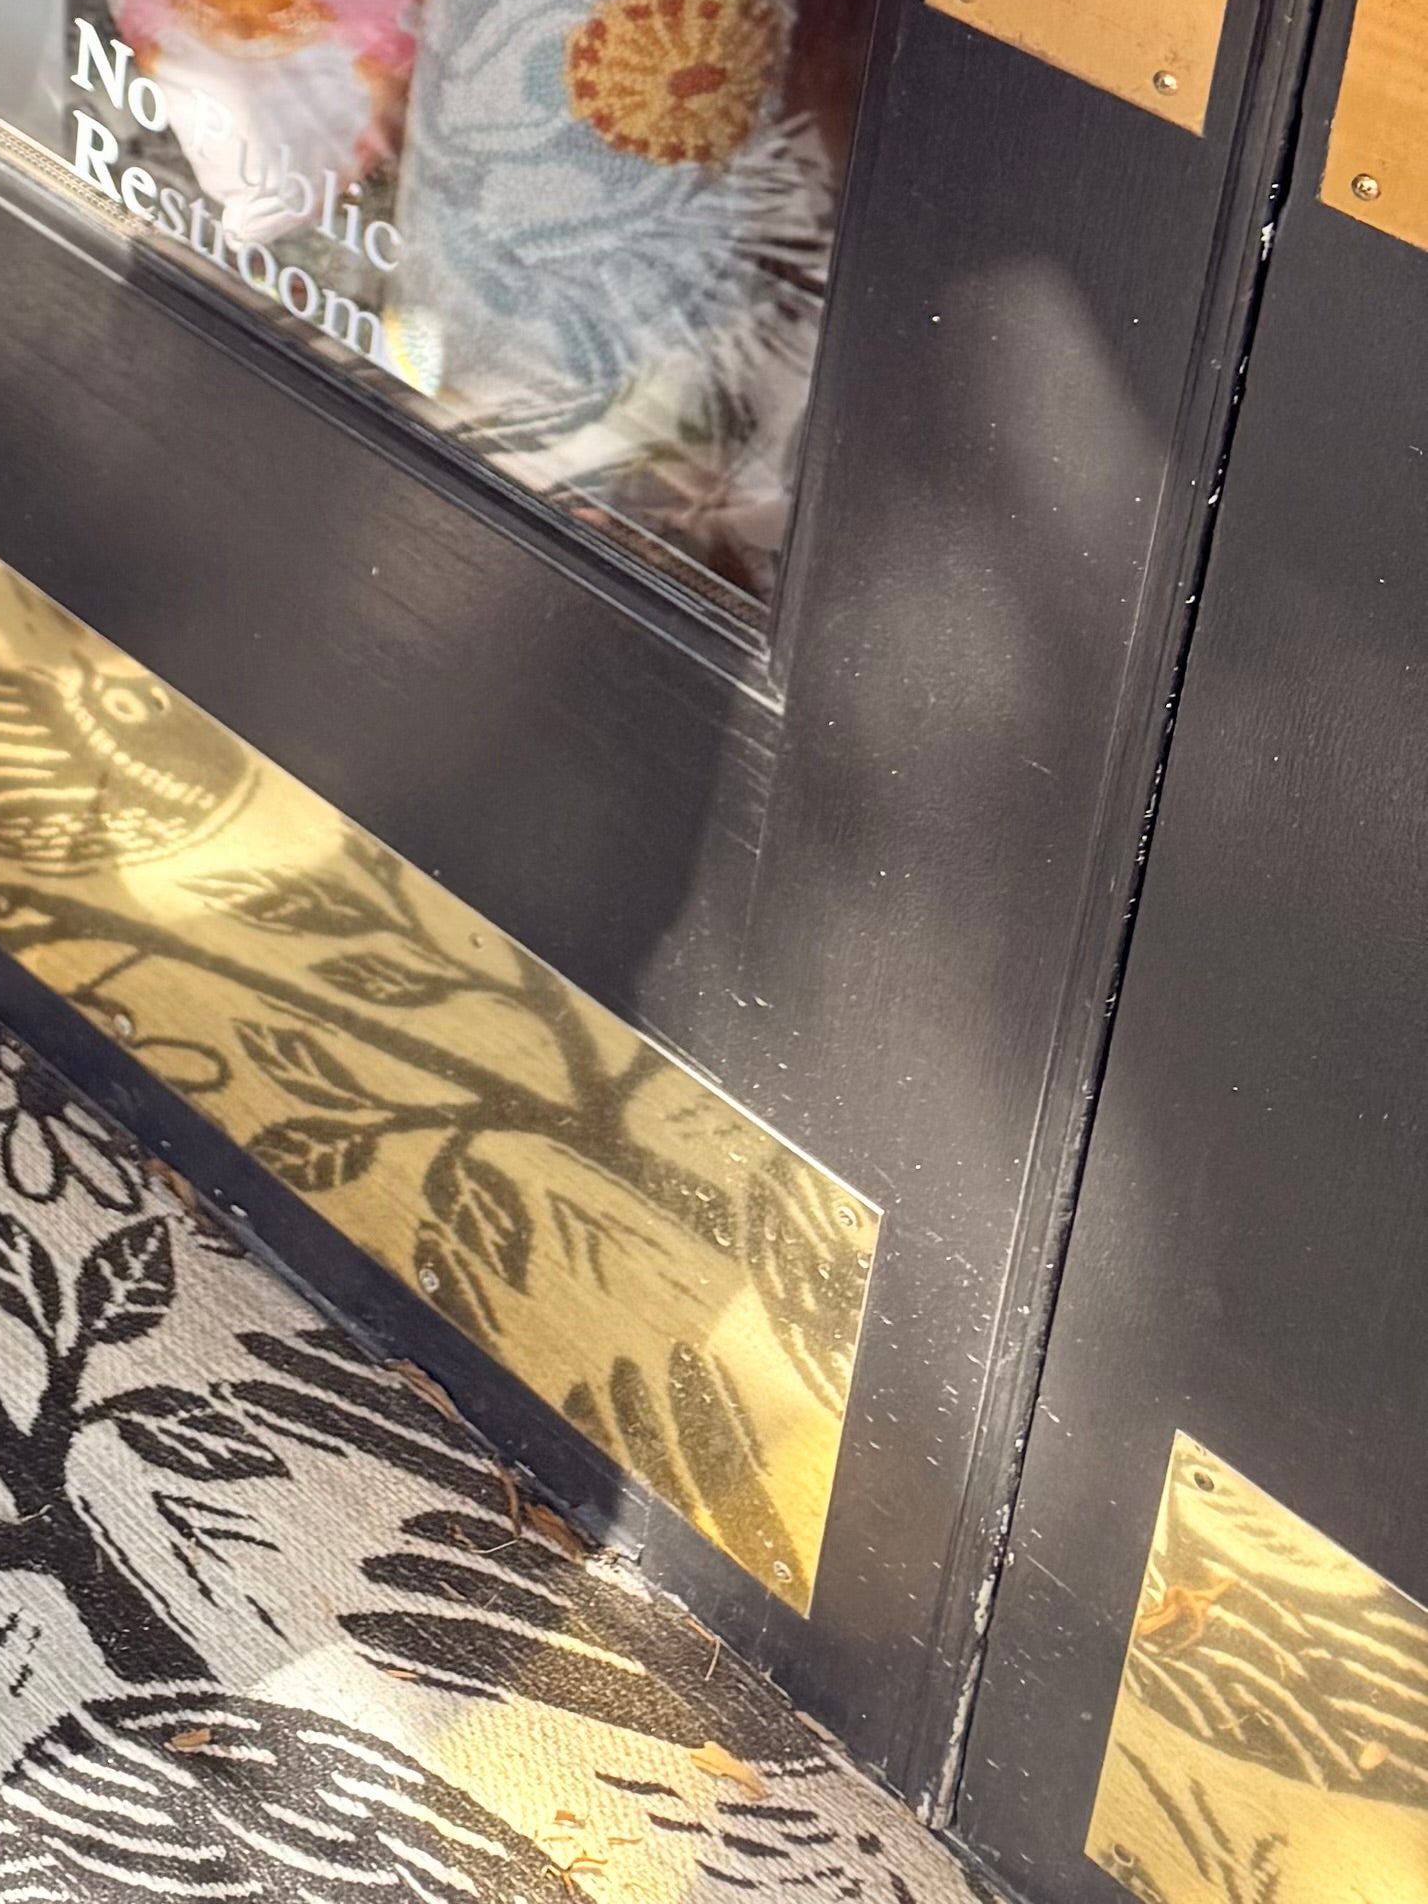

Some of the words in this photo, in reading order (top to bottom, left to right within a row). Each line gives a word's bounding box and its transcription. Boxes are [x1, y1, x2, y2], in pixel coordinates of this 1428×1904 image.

[70, 17, 168, 132] No
[191, 87, 403, 271] Public
[72, 110, 388, 360] Restroom
